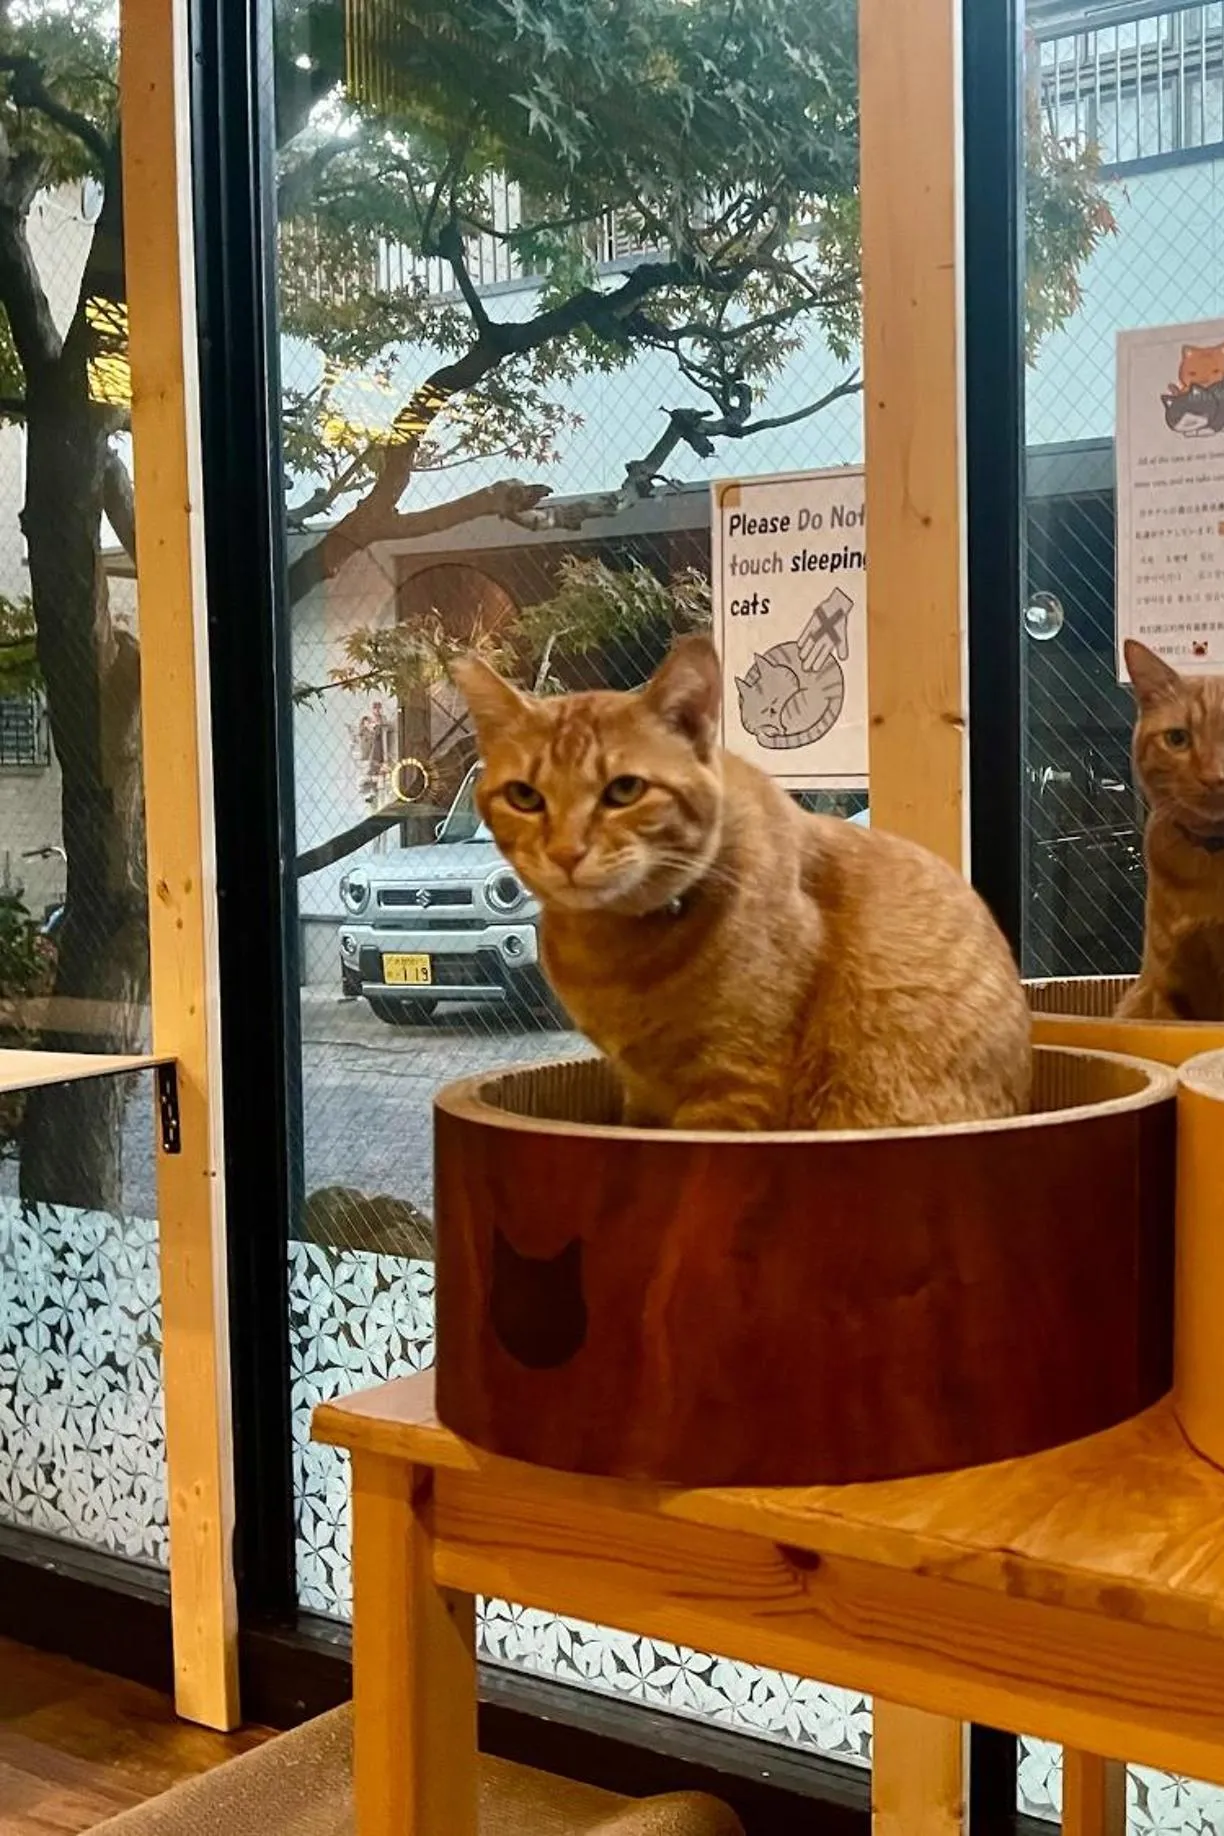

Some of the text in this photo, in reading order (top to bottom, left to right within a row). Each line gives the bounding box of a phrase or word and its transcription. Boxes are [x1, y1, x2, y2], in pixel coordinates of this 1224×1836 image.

[729, 513, 790, 537] Please
[798, 508, 823, 531] Do
[730, 545, 867, 577] touch sleepin
[731, 592, 771, 617] cats
